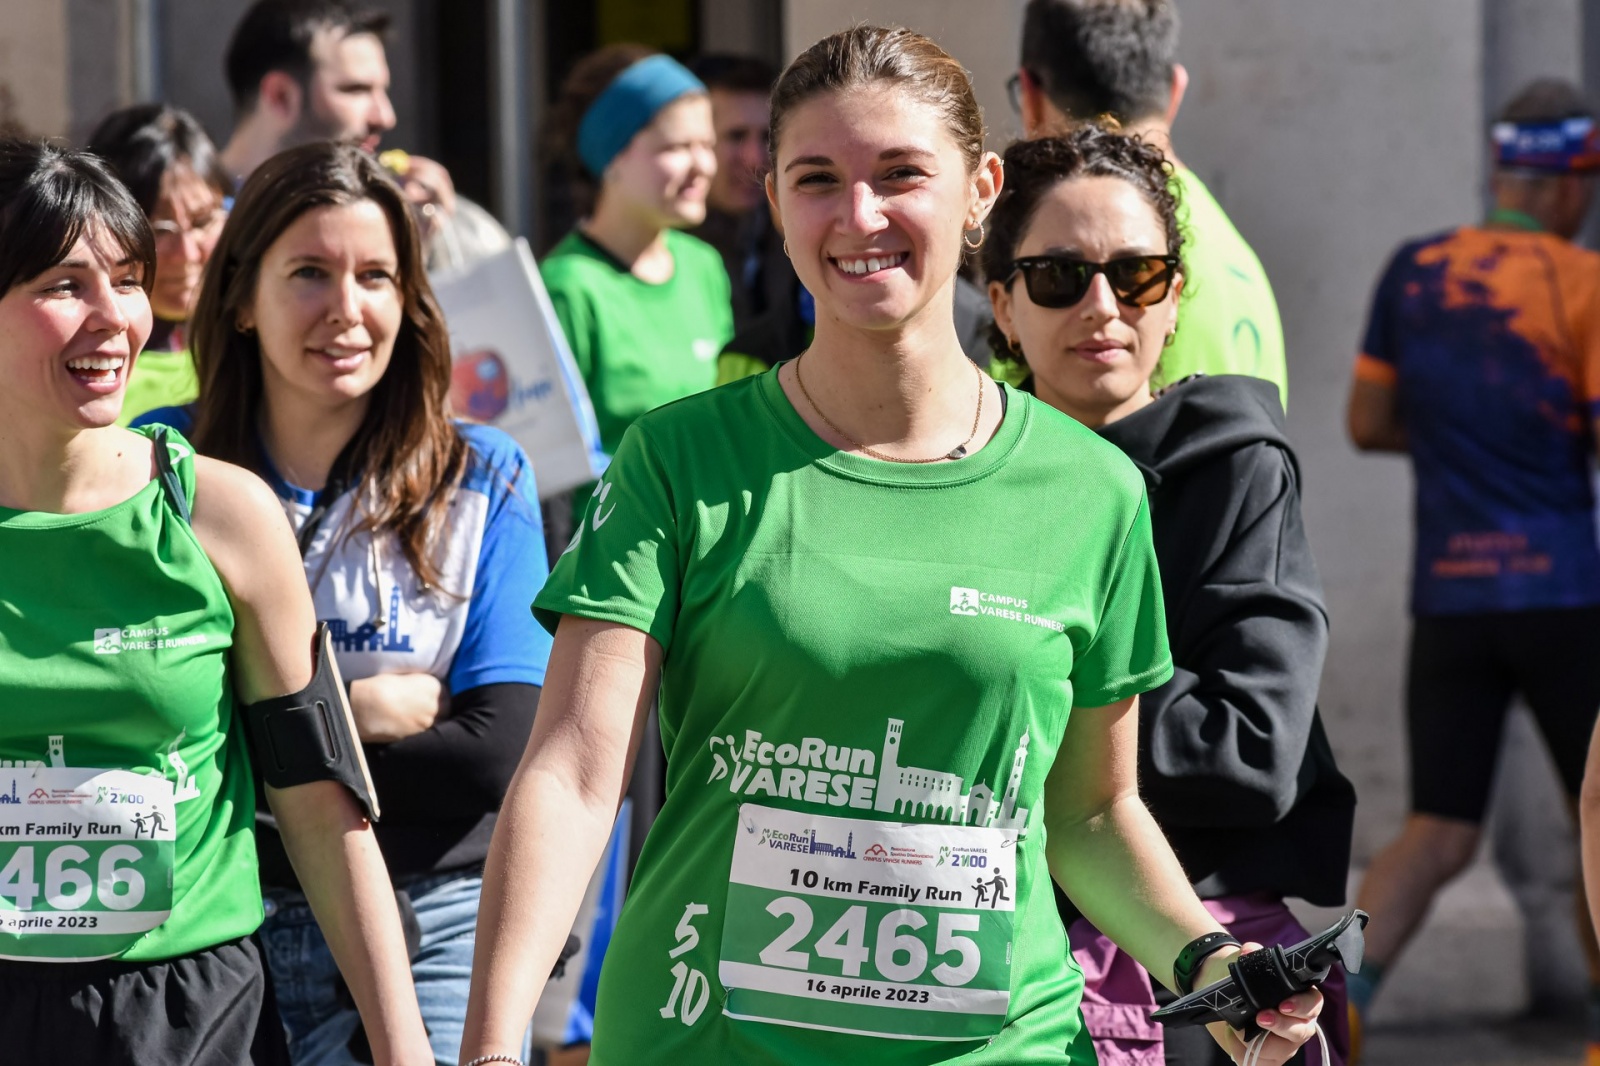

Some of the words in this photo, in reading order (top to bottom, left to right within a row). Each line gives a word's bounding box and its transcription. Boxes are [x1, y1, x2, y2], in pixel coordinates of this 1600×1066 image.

[980, 592, 1028, 609] CAMPUS
[980, 606, 1021, 622] VARESE
[121, 627, 169, 639] CAMPUS
[121, 639, 164, 651] VARESE
[165, 634, 208, 648] RUNN
[743, 729, 876, 775] EcoRun
[730, 762, 877, 810] VARESE
[25, 822, 83, 838] Family
[87, 822, 122, 835] Run
[772, 830, 809, 844] EcoRun
[769, 839, 810, 854] VARESE
[790, 868, 819, 888] 10
[823, 877, 853, 893] km
[857, 880, 921, 900] Family
[925, 886, 963, 902] Run
[8, 916, 53, 930] aprile
[57, 916, 98, 928] 2023
[668, 902, 709, 959] 5
[758, 896, 982, 987] 2465
[659, 961, 710, 1027] 10
[806, 979, 827, 993] 16
[830, 984, 881, 1000] aprile
[885, 988, 929, 1004] 2023
